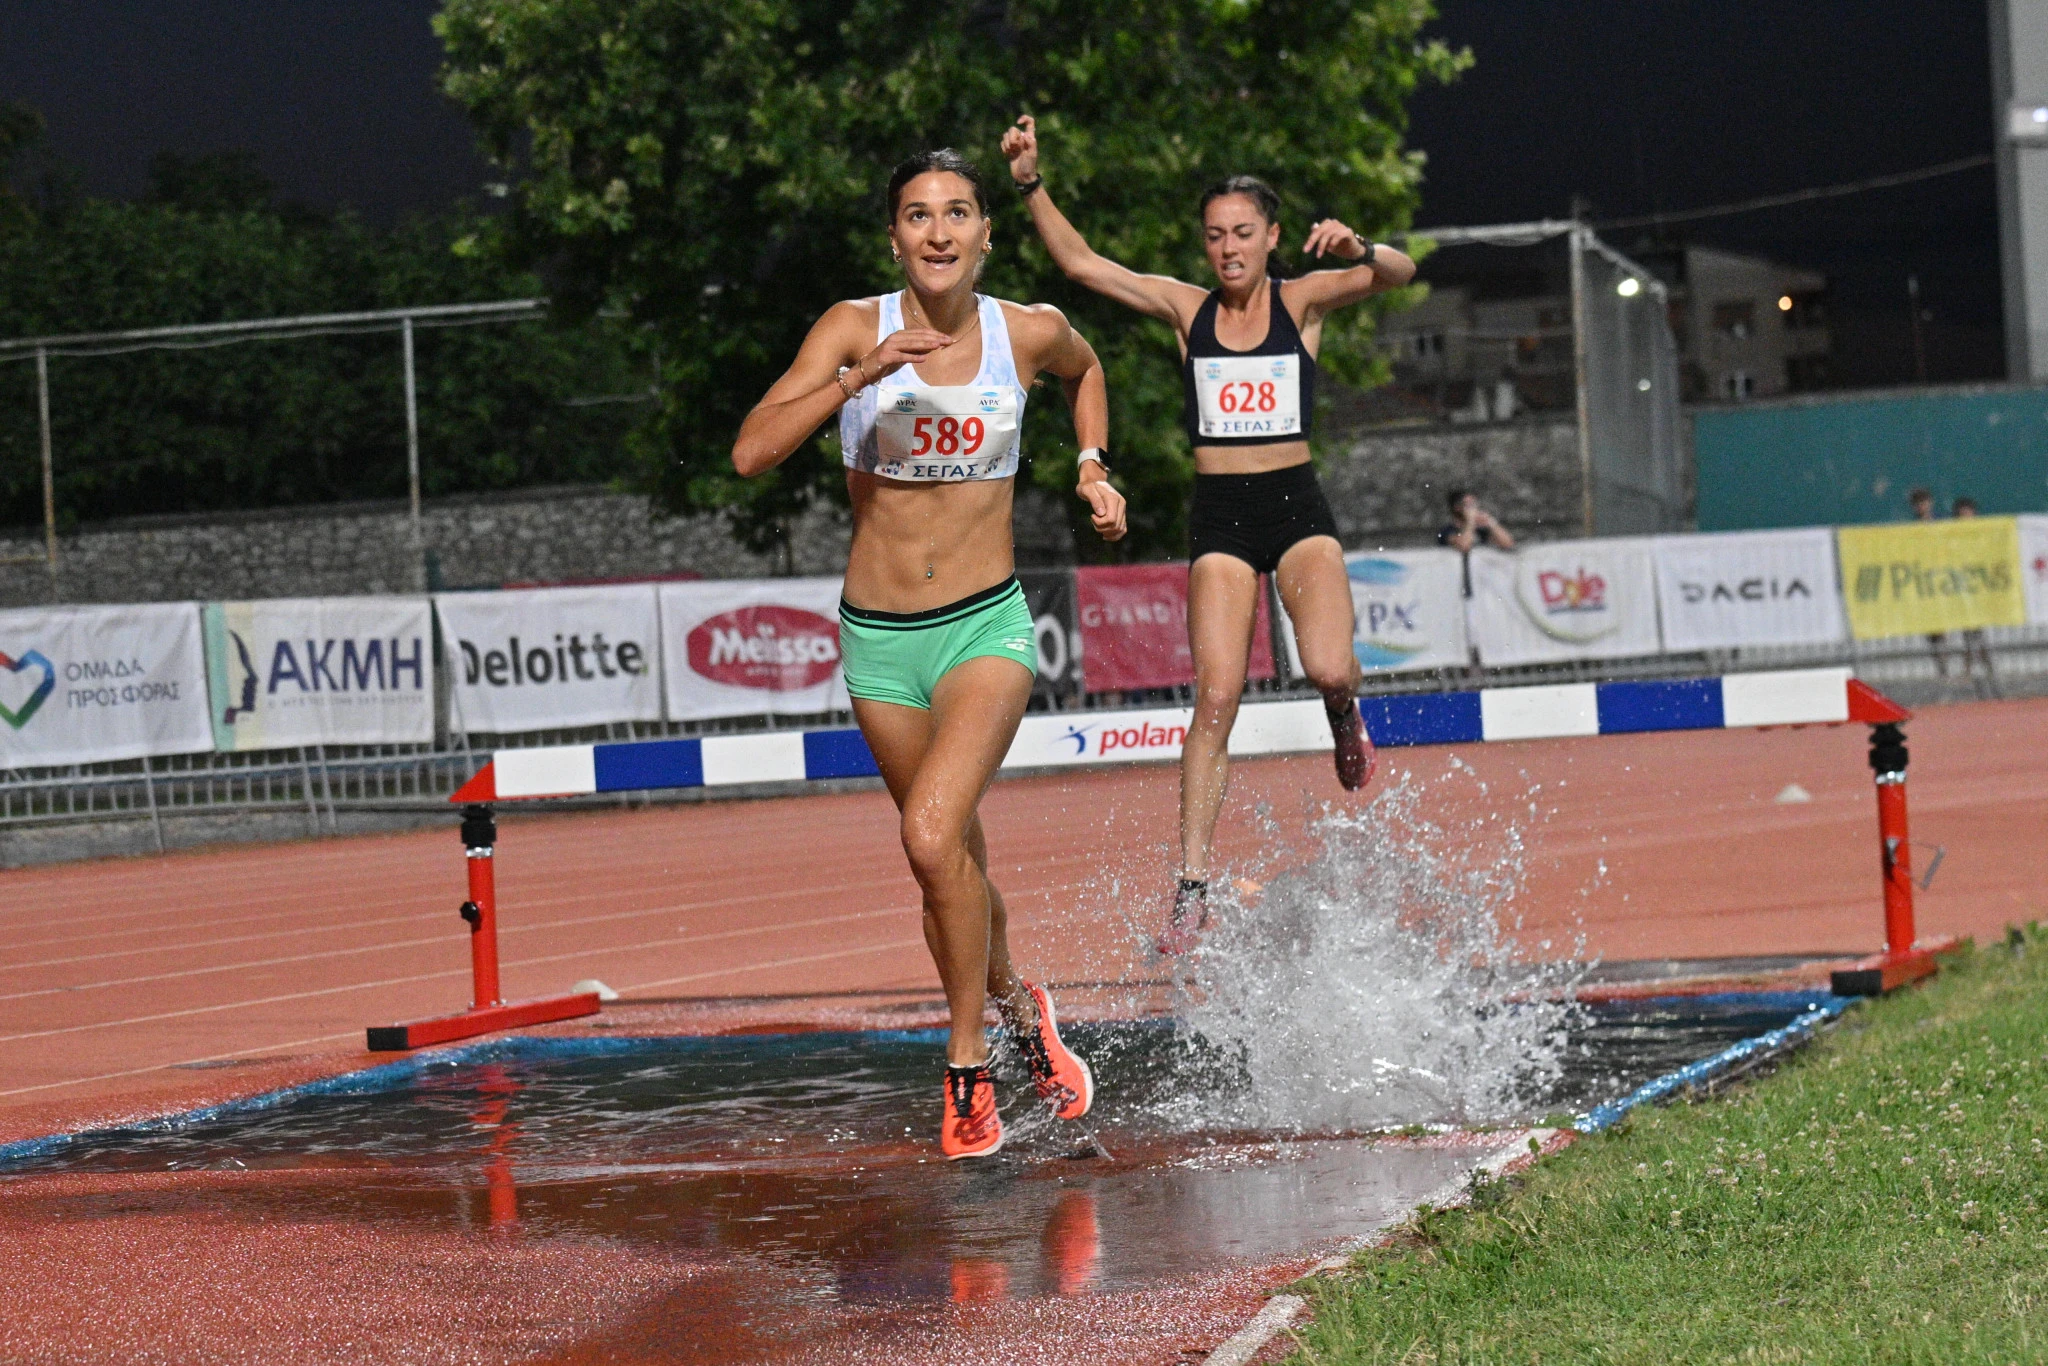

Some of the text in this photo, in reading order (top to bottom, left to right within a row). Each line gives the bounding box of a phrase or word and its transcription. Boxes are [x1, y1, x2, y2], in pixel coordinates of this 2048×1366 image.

[1219, 380, 1277, 413] 628
[911, 416, 985, 456] 589
[1223, 420, 1275, 432] ΣΕΓΑΣ
[913, 464, 979, 478] ΣΕΓΑΣ
[1680, 576, 1812, 603] DACIA
[65, 658, 146, 682] ΟΜΑΔΑ
[267, 637, 424, 694] ΑΚΜΗ
[67, 681, 181, 708] ΠΡΟΣΦΟΡΑΣ
[1098, 721, 1186, 757] polan
